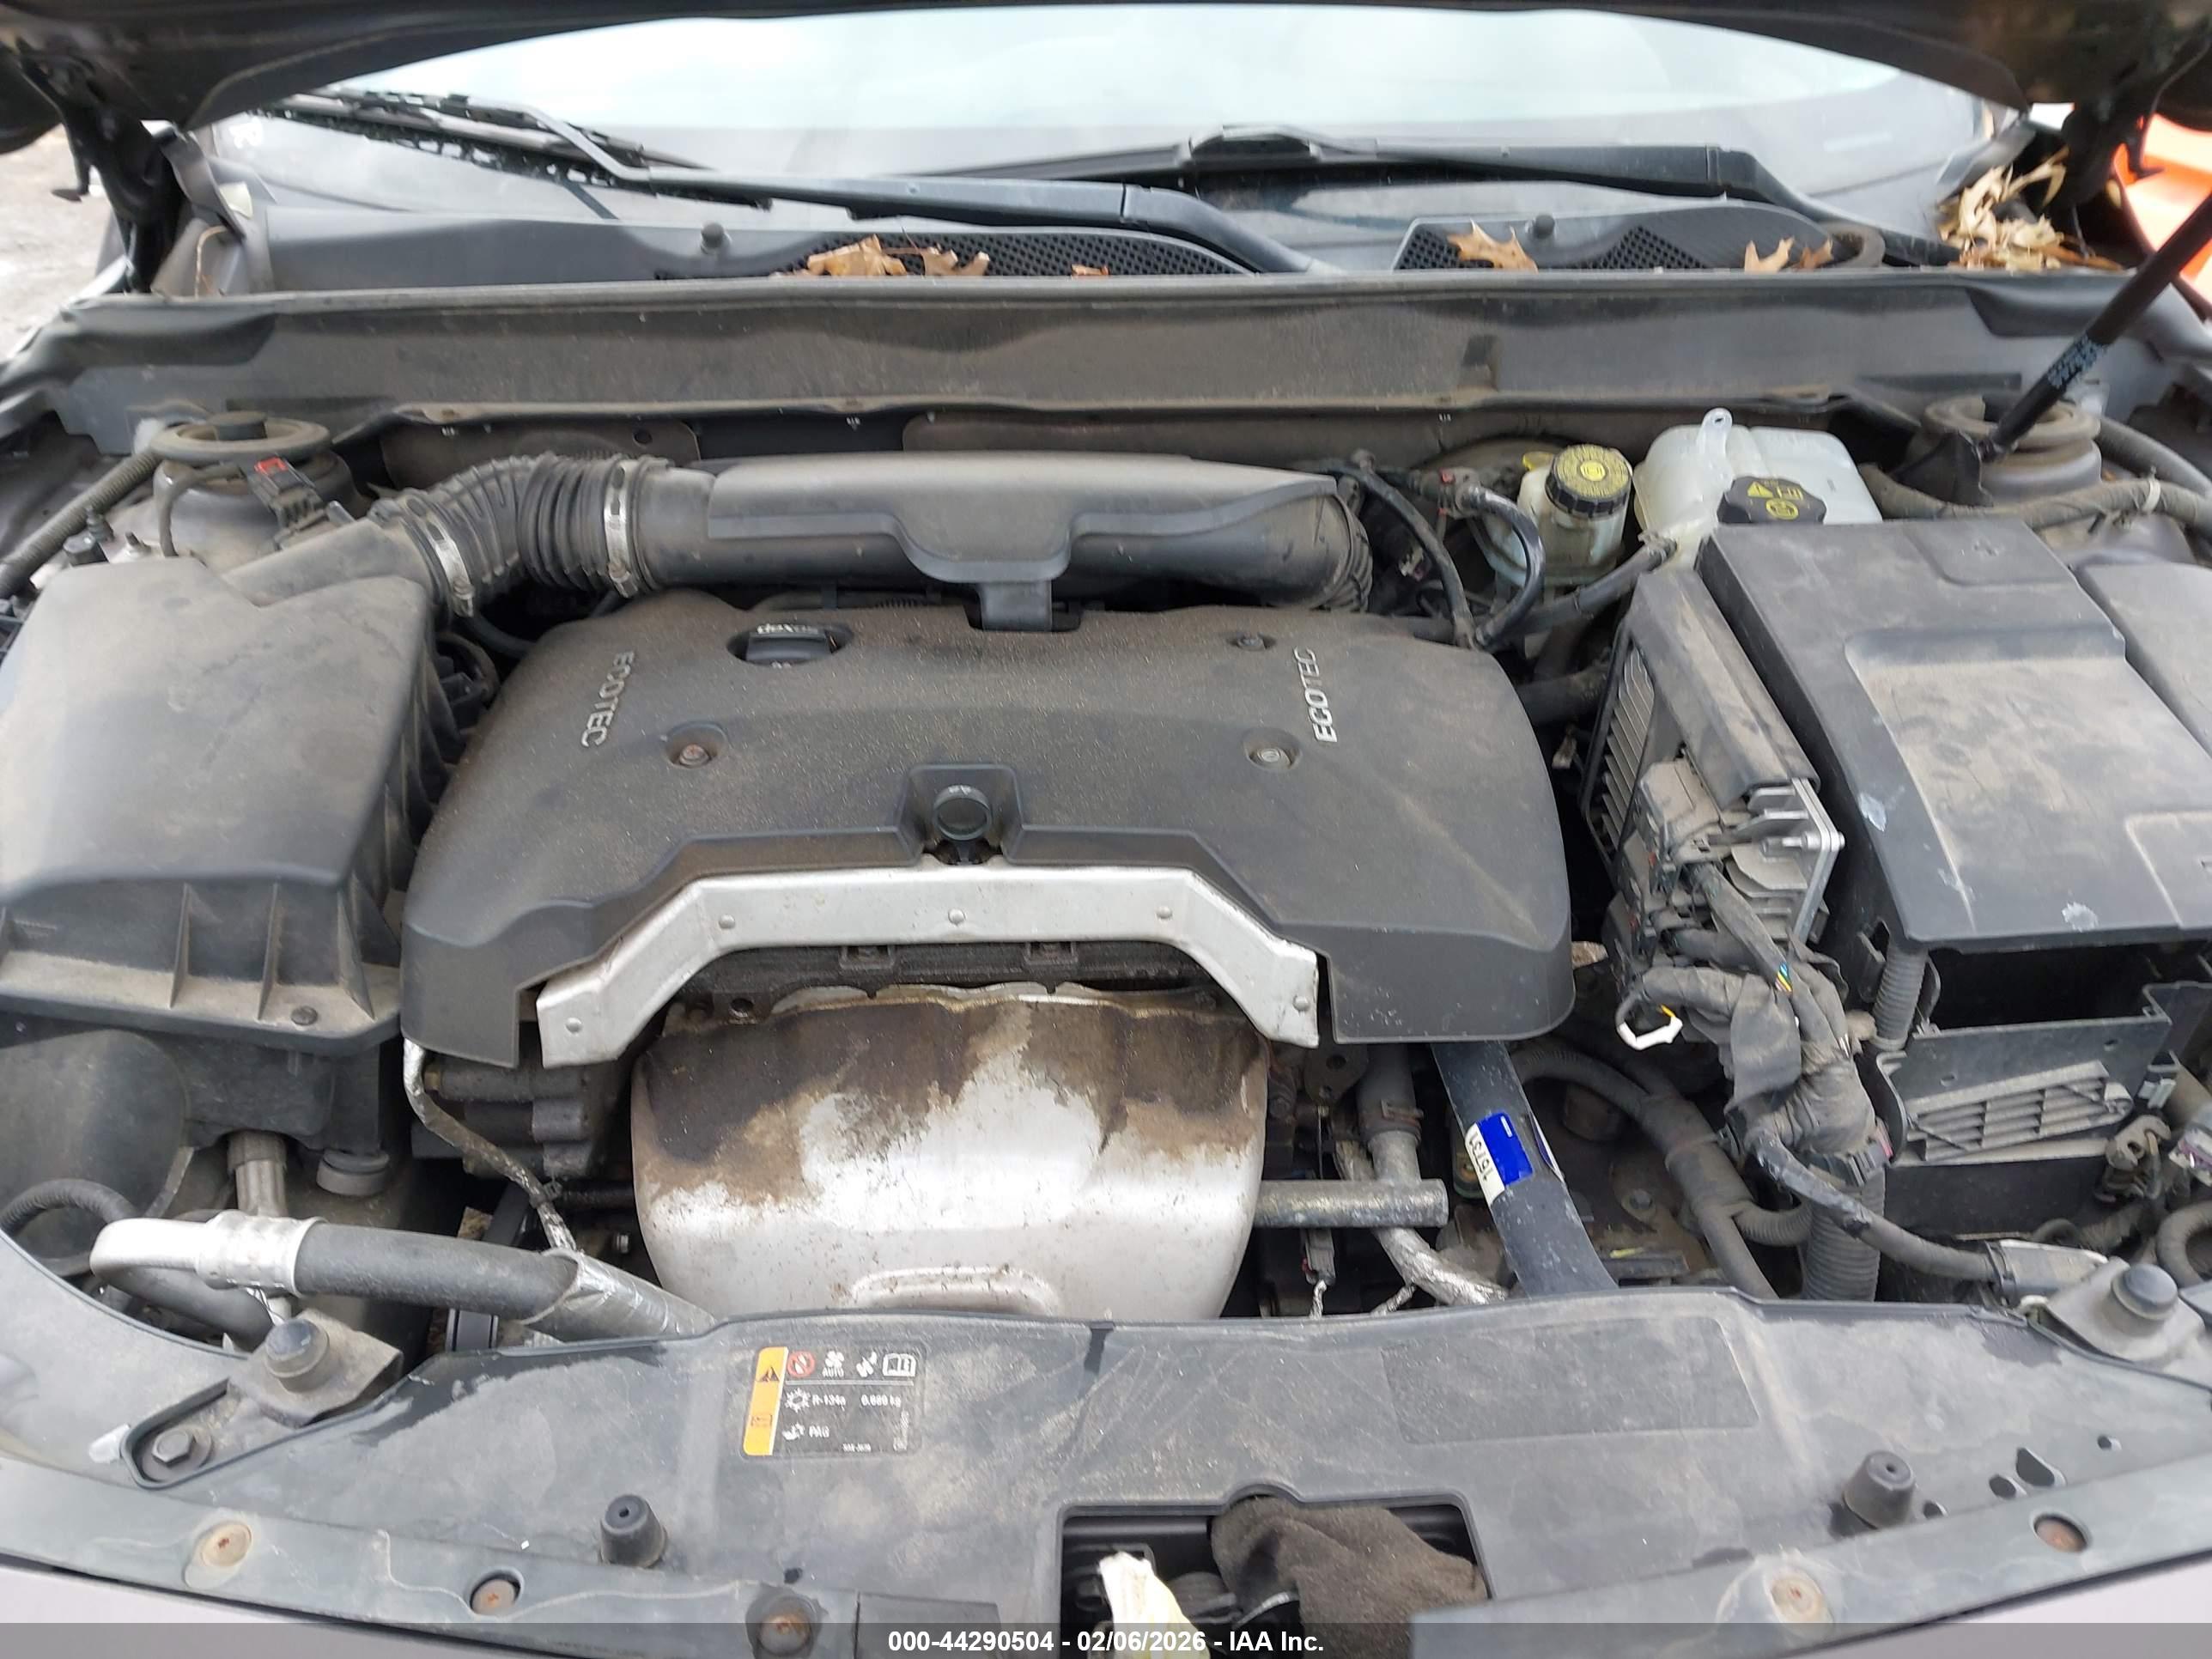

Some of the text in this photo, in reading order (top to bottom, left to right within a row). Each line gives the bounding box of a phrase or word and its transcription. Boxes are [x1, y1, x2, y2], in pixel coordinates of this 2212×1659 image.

[581, 651, 635, 746] ECOTEC
[1293, 646, 1337, 743] ECOTEC
[822, 1367, 844, 1377] AUTO
